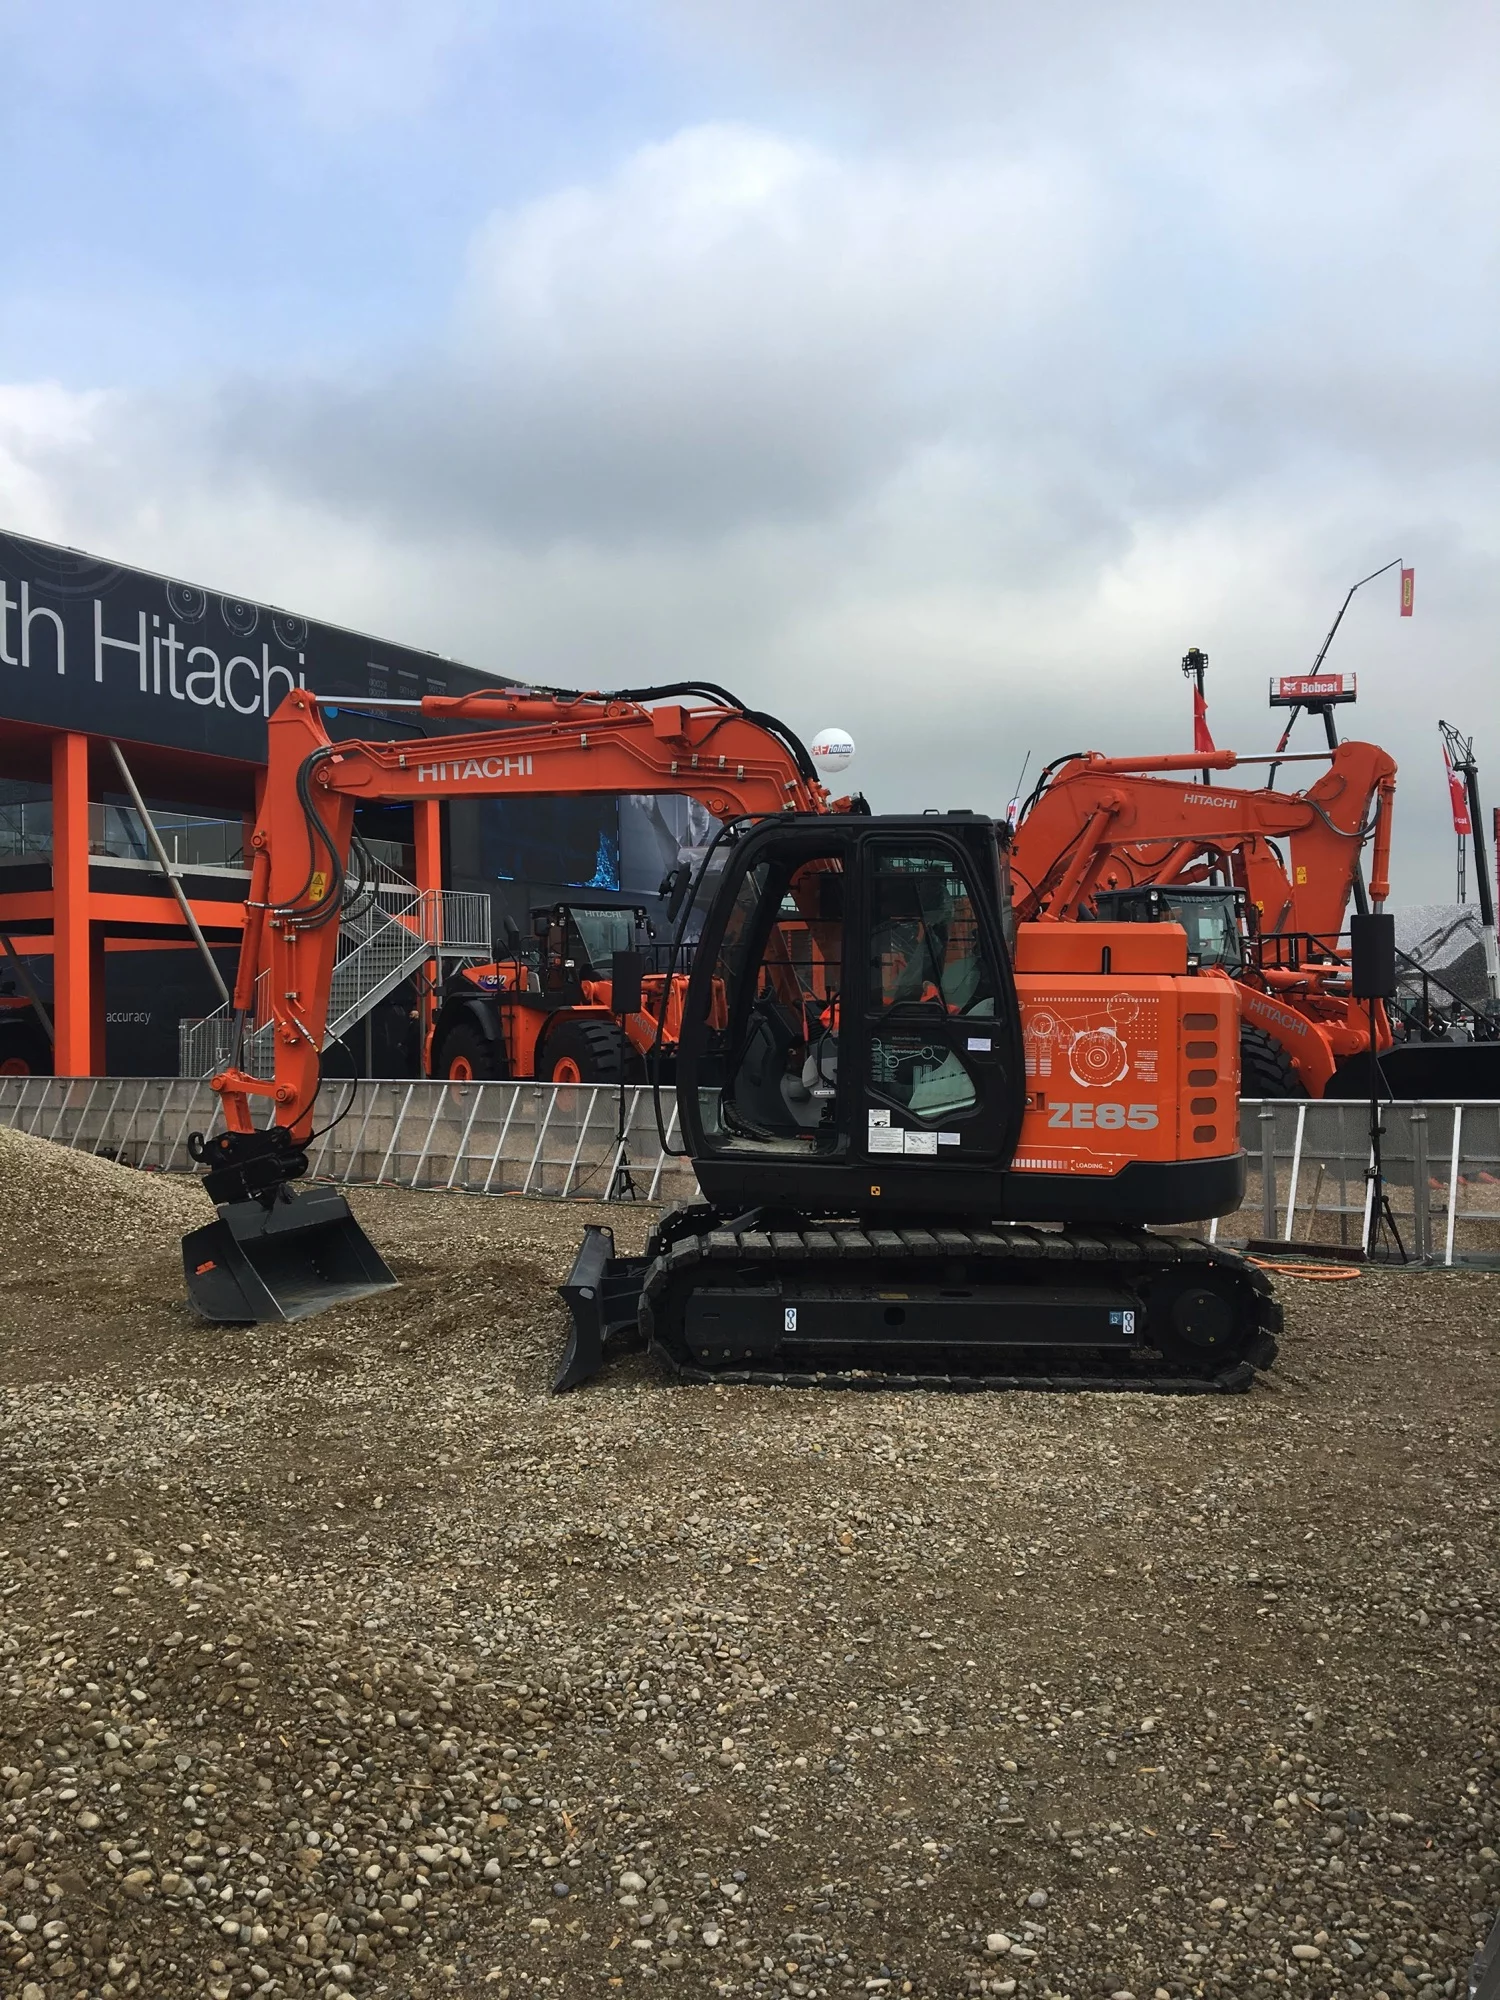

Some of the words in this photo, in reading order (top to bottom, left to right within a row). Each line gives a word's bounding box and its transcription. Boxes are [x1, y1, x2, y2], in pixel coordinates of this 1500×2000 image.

[0, 580, 65, 675] th
[1301, 681, 1337, 693] Bobcat
[418, 755, 533, 782] HITACHI
[1184, 793, 1237, 809] HITACHI
[584, 910, 622, 918] HITACHI
[106, 1012, 151, 1025] accuracy
[1249, 998, 1309, 1037] HITACHI
[1048, 1103, 1159, 1130] ZE85
[1076, 1162, 1109, 1170] LOADING...
